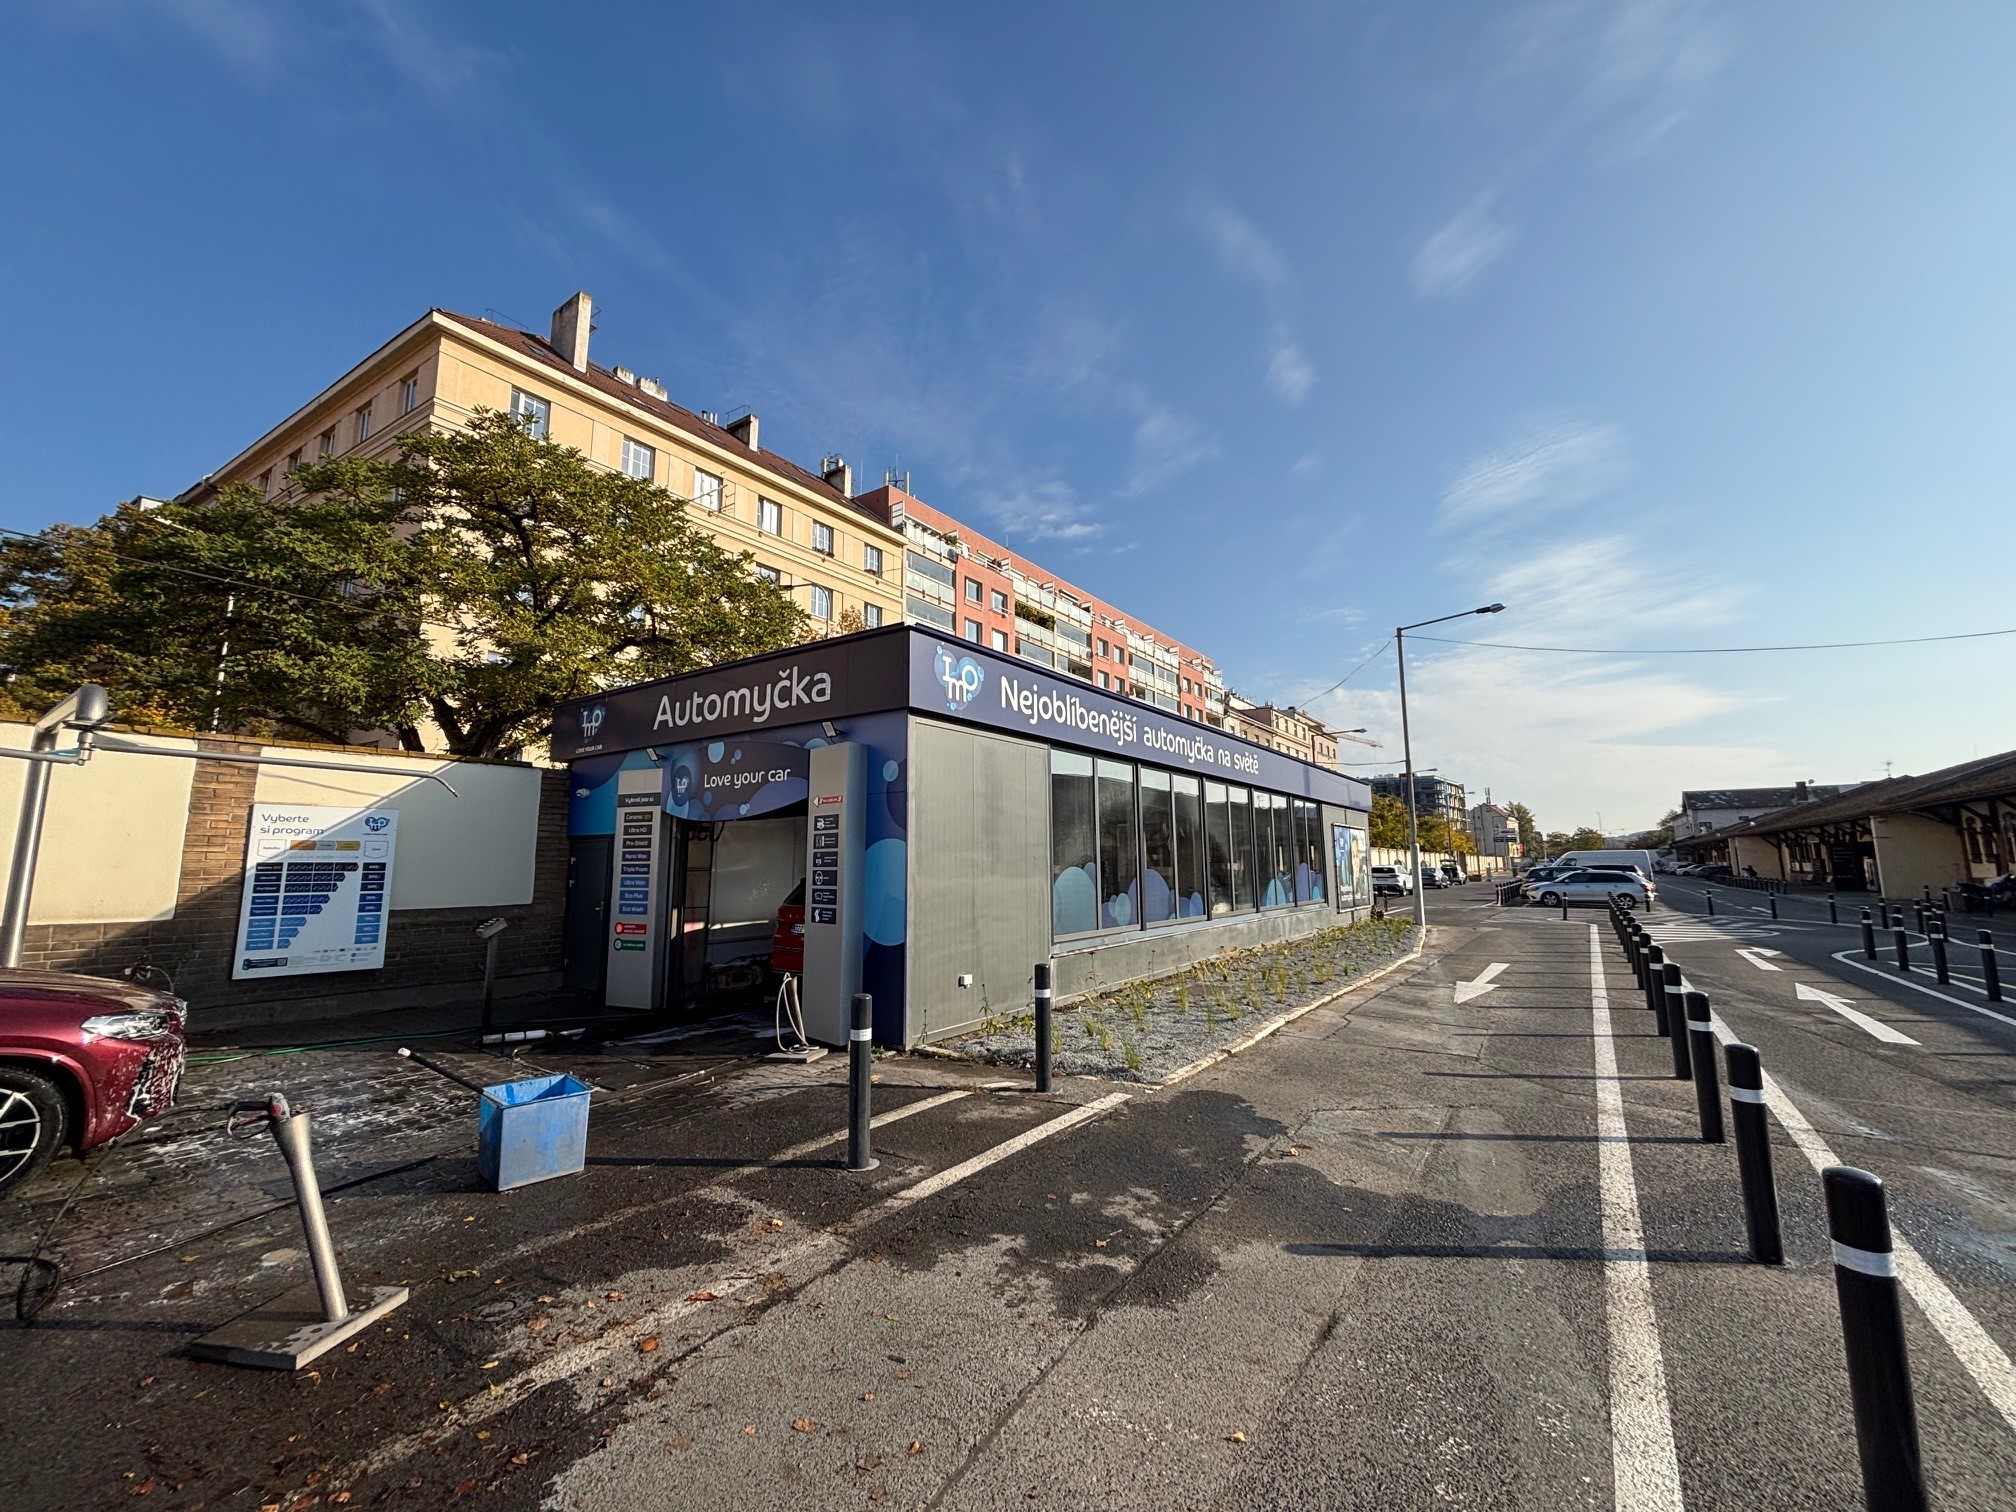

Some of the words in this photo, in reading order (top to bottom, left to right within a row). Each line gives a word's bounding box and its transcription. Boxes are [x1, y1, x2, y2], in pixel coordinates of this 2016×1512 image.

[653, 666, 832, 731] Automyčka
[1000, 675, 1138, 746] Nejoblíbenější
[1143, 725, 1214, 764] automyčka
[1217, 748, 1231, 767] na
[1233, 749, 1259, 775] světě
[704, 772, 731, 788] Love
[733, 770, 764, 789] your
[768, 768, 790, 781] car
[261, 813, 310, 824] Vyberte
[260, 826, 270, 834] si
[272, 826, 324, 836] program
